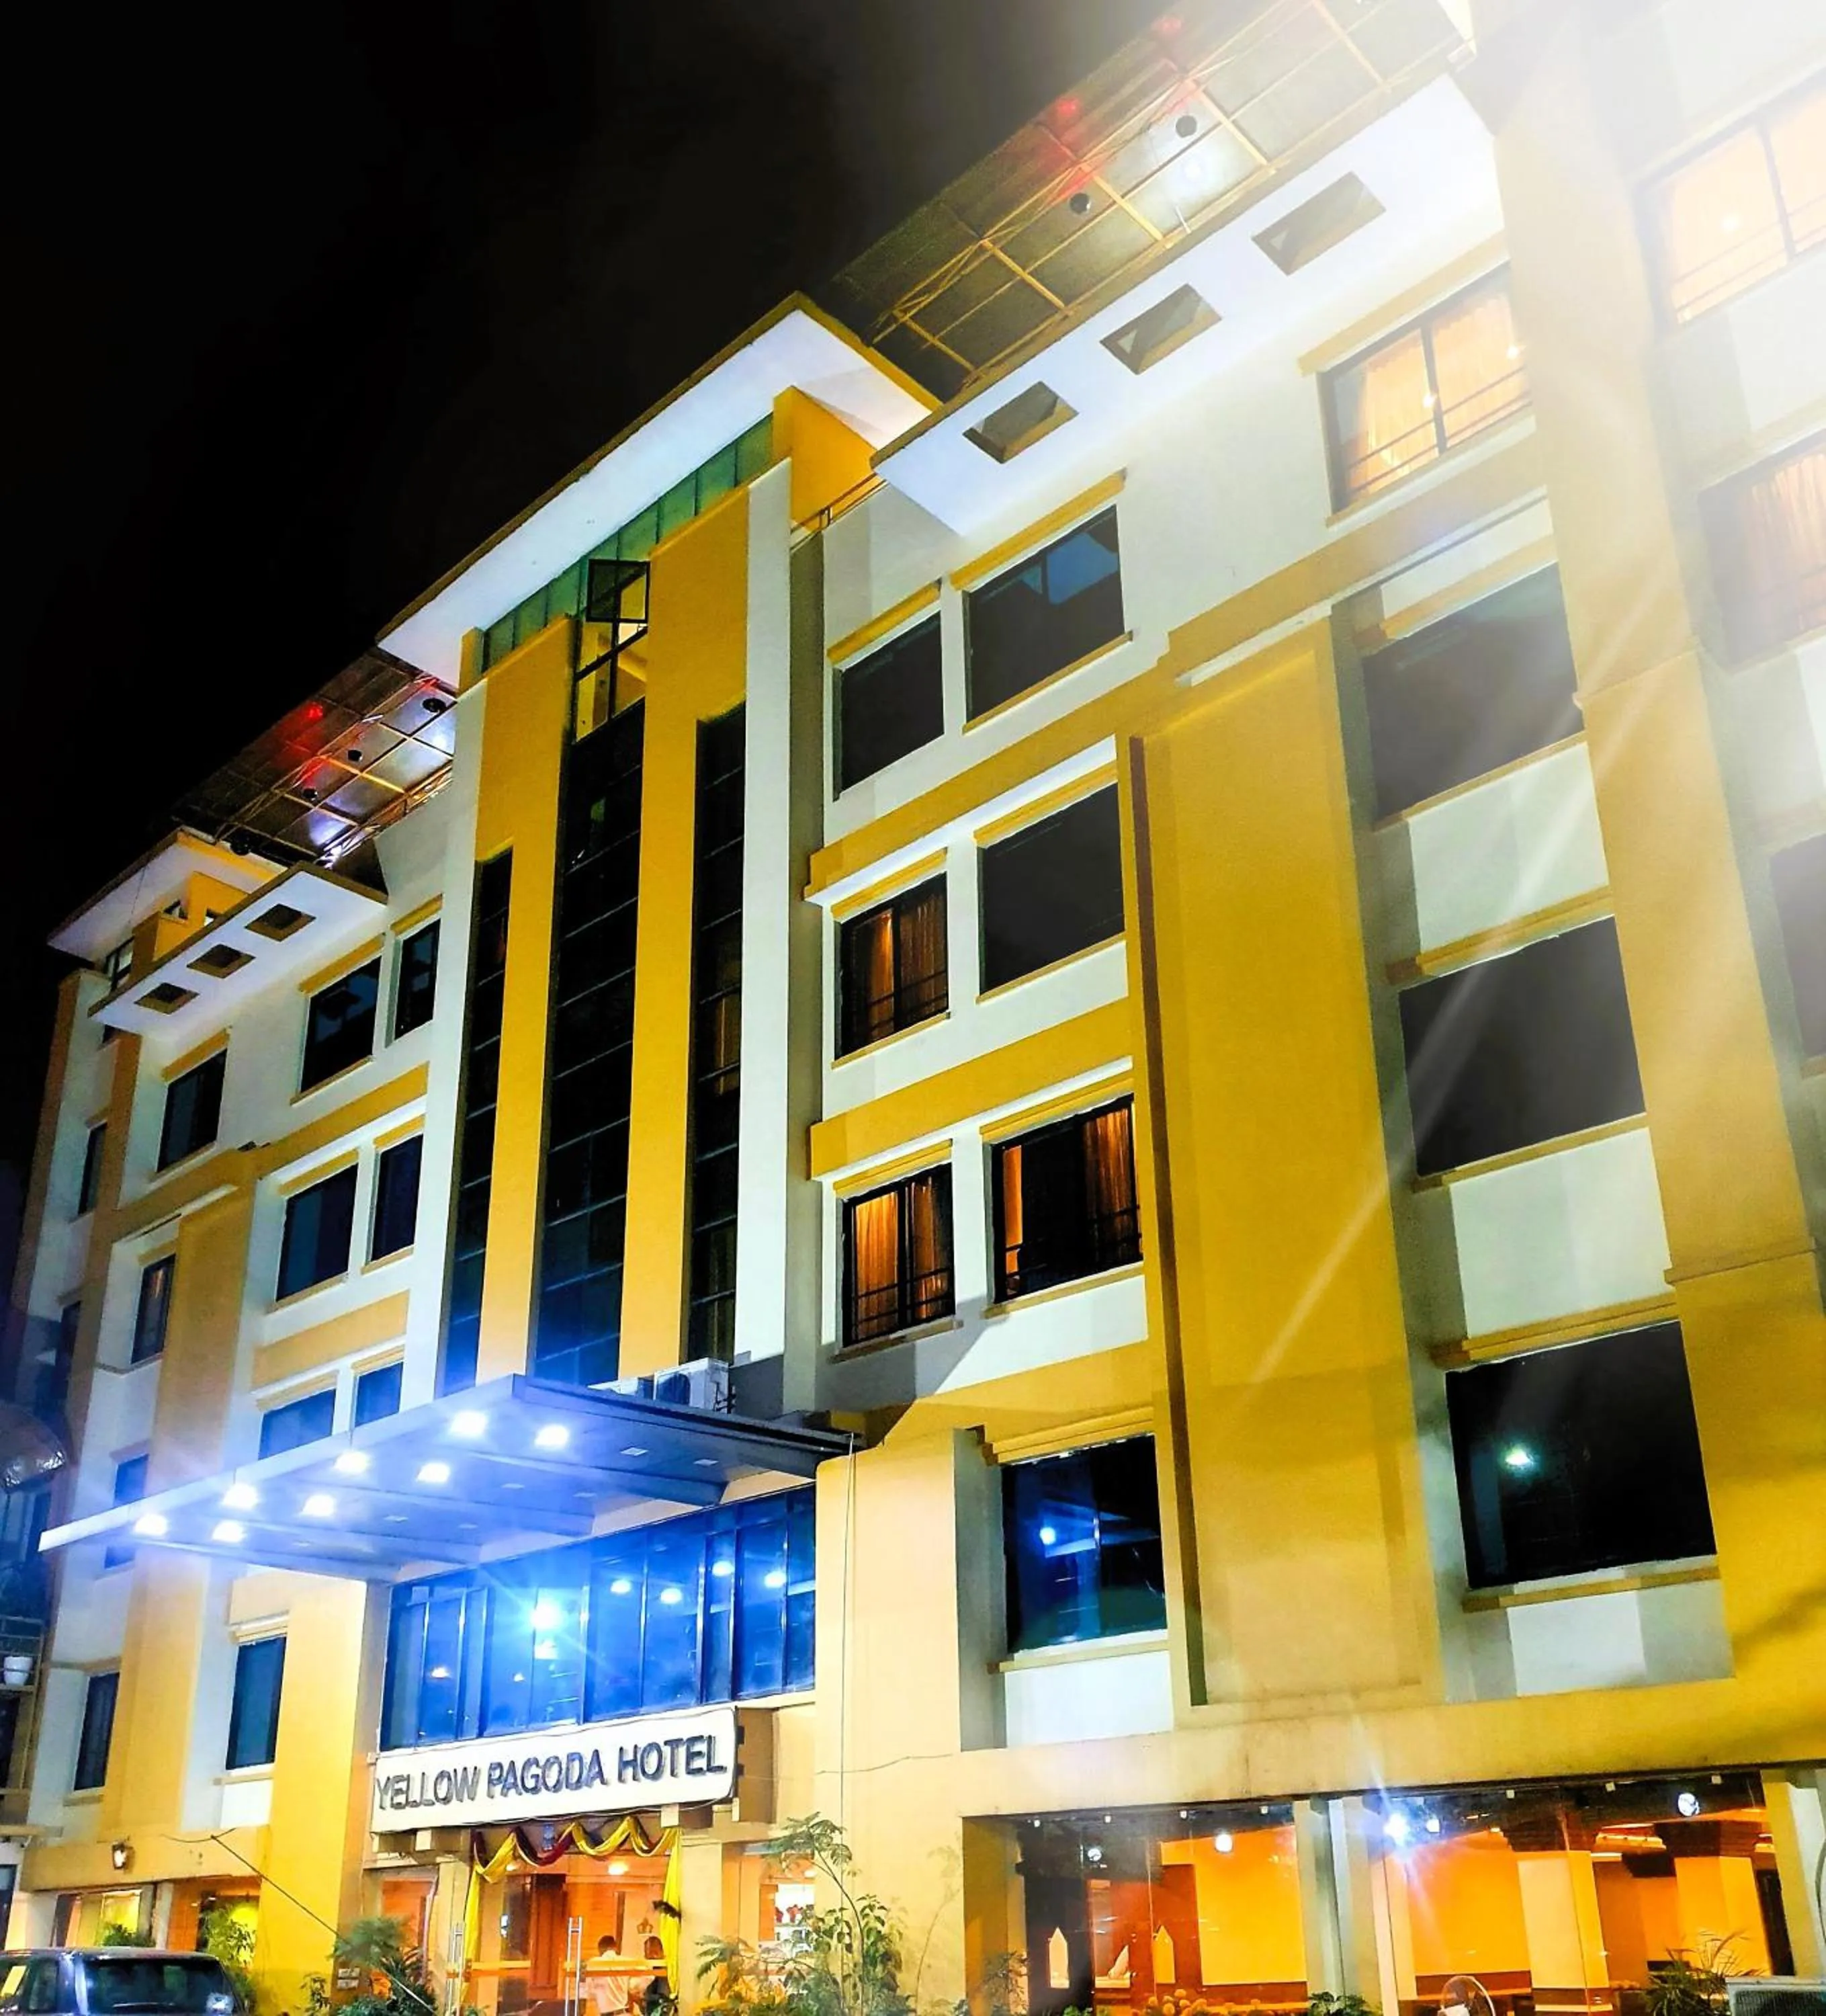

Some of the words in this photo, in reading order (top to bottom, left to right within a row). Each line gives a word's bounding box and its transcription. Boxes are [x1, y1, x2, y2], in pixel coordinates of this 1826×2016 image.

[376, 1765, 481, 1810] YELLOW
[486, 1749, 609, 1800] PAGODA
[617, 1734, 728, 1784] HOTEL
